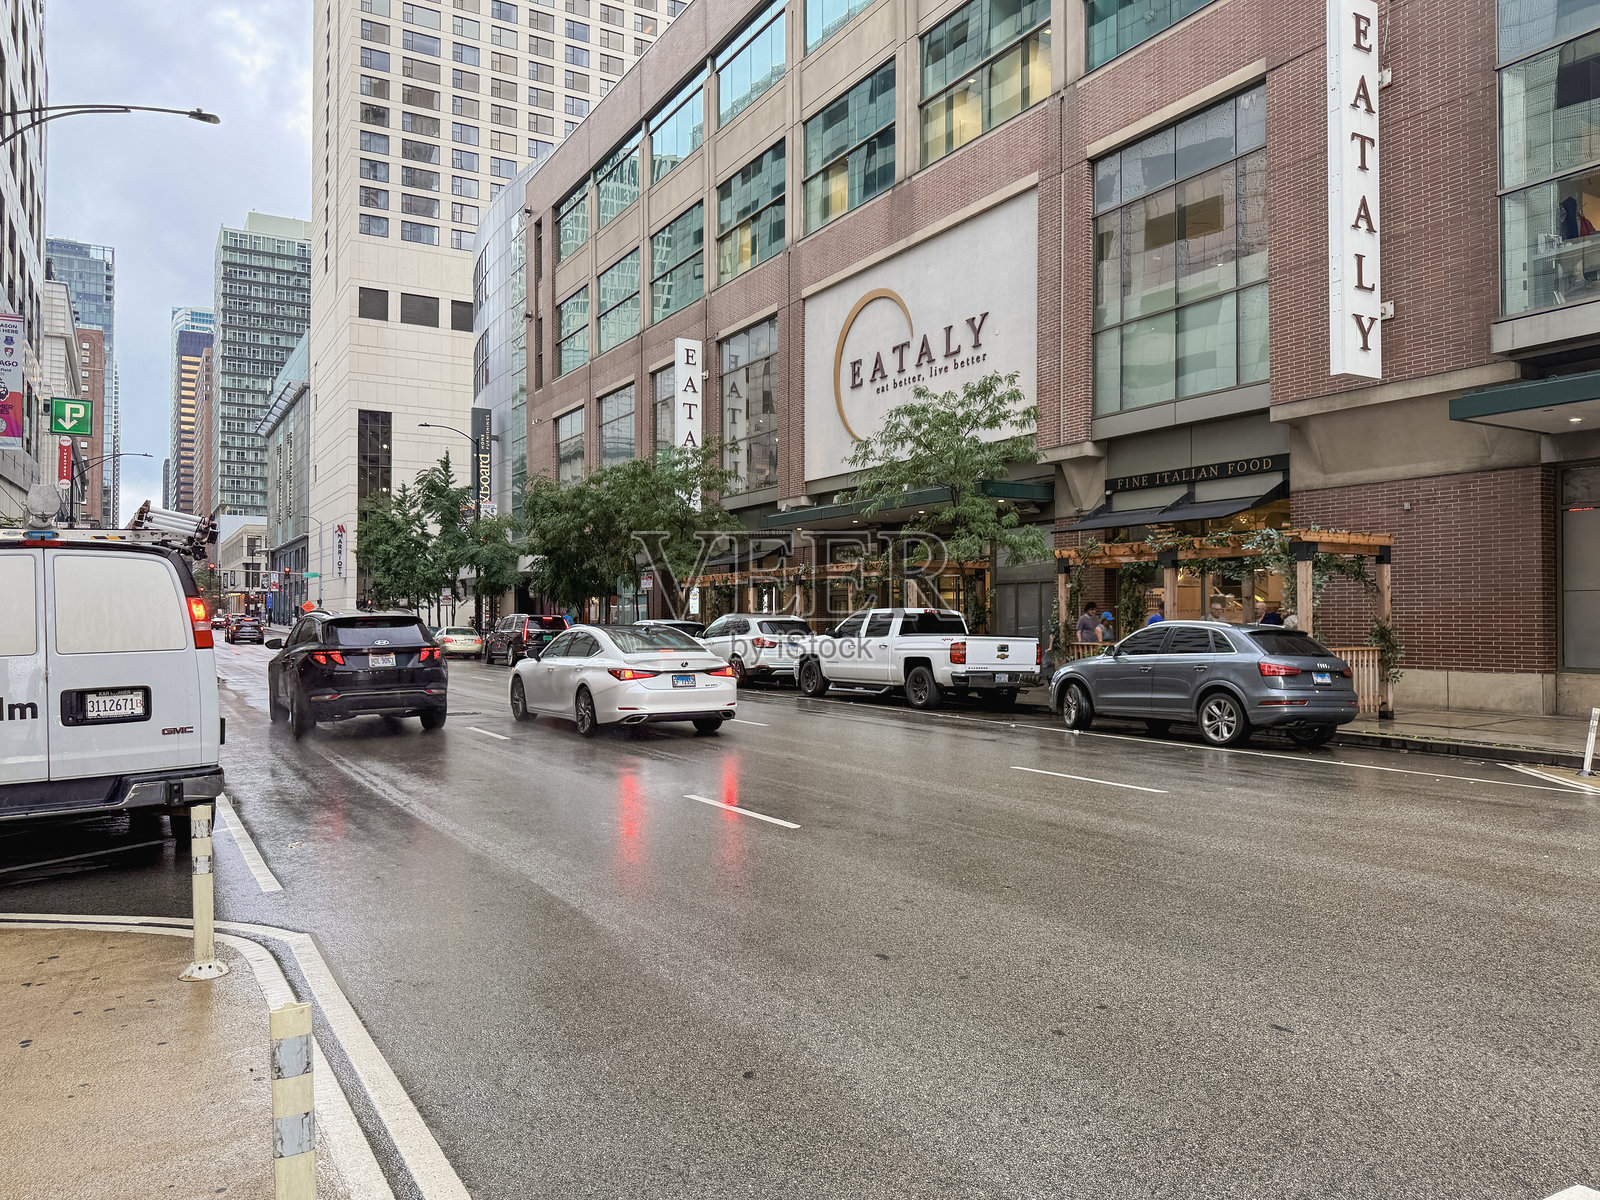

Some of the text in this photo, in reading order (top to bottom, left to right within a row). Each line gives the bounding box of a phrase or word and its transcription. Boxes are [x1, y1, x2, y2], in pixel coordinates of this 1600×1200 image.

[1350, 12, 1378, 351] EATALY
[850, 311, 989, 389] EATALY
[876, 352, 987, 394] eat better, live better
[682, 348, 698, 447] EATA
[1117, 458, 1272, 490] FINE ITALIAN FOOD
[88, 698, 136, 712] 3112671
[162, 726, 194, 736] GMC
